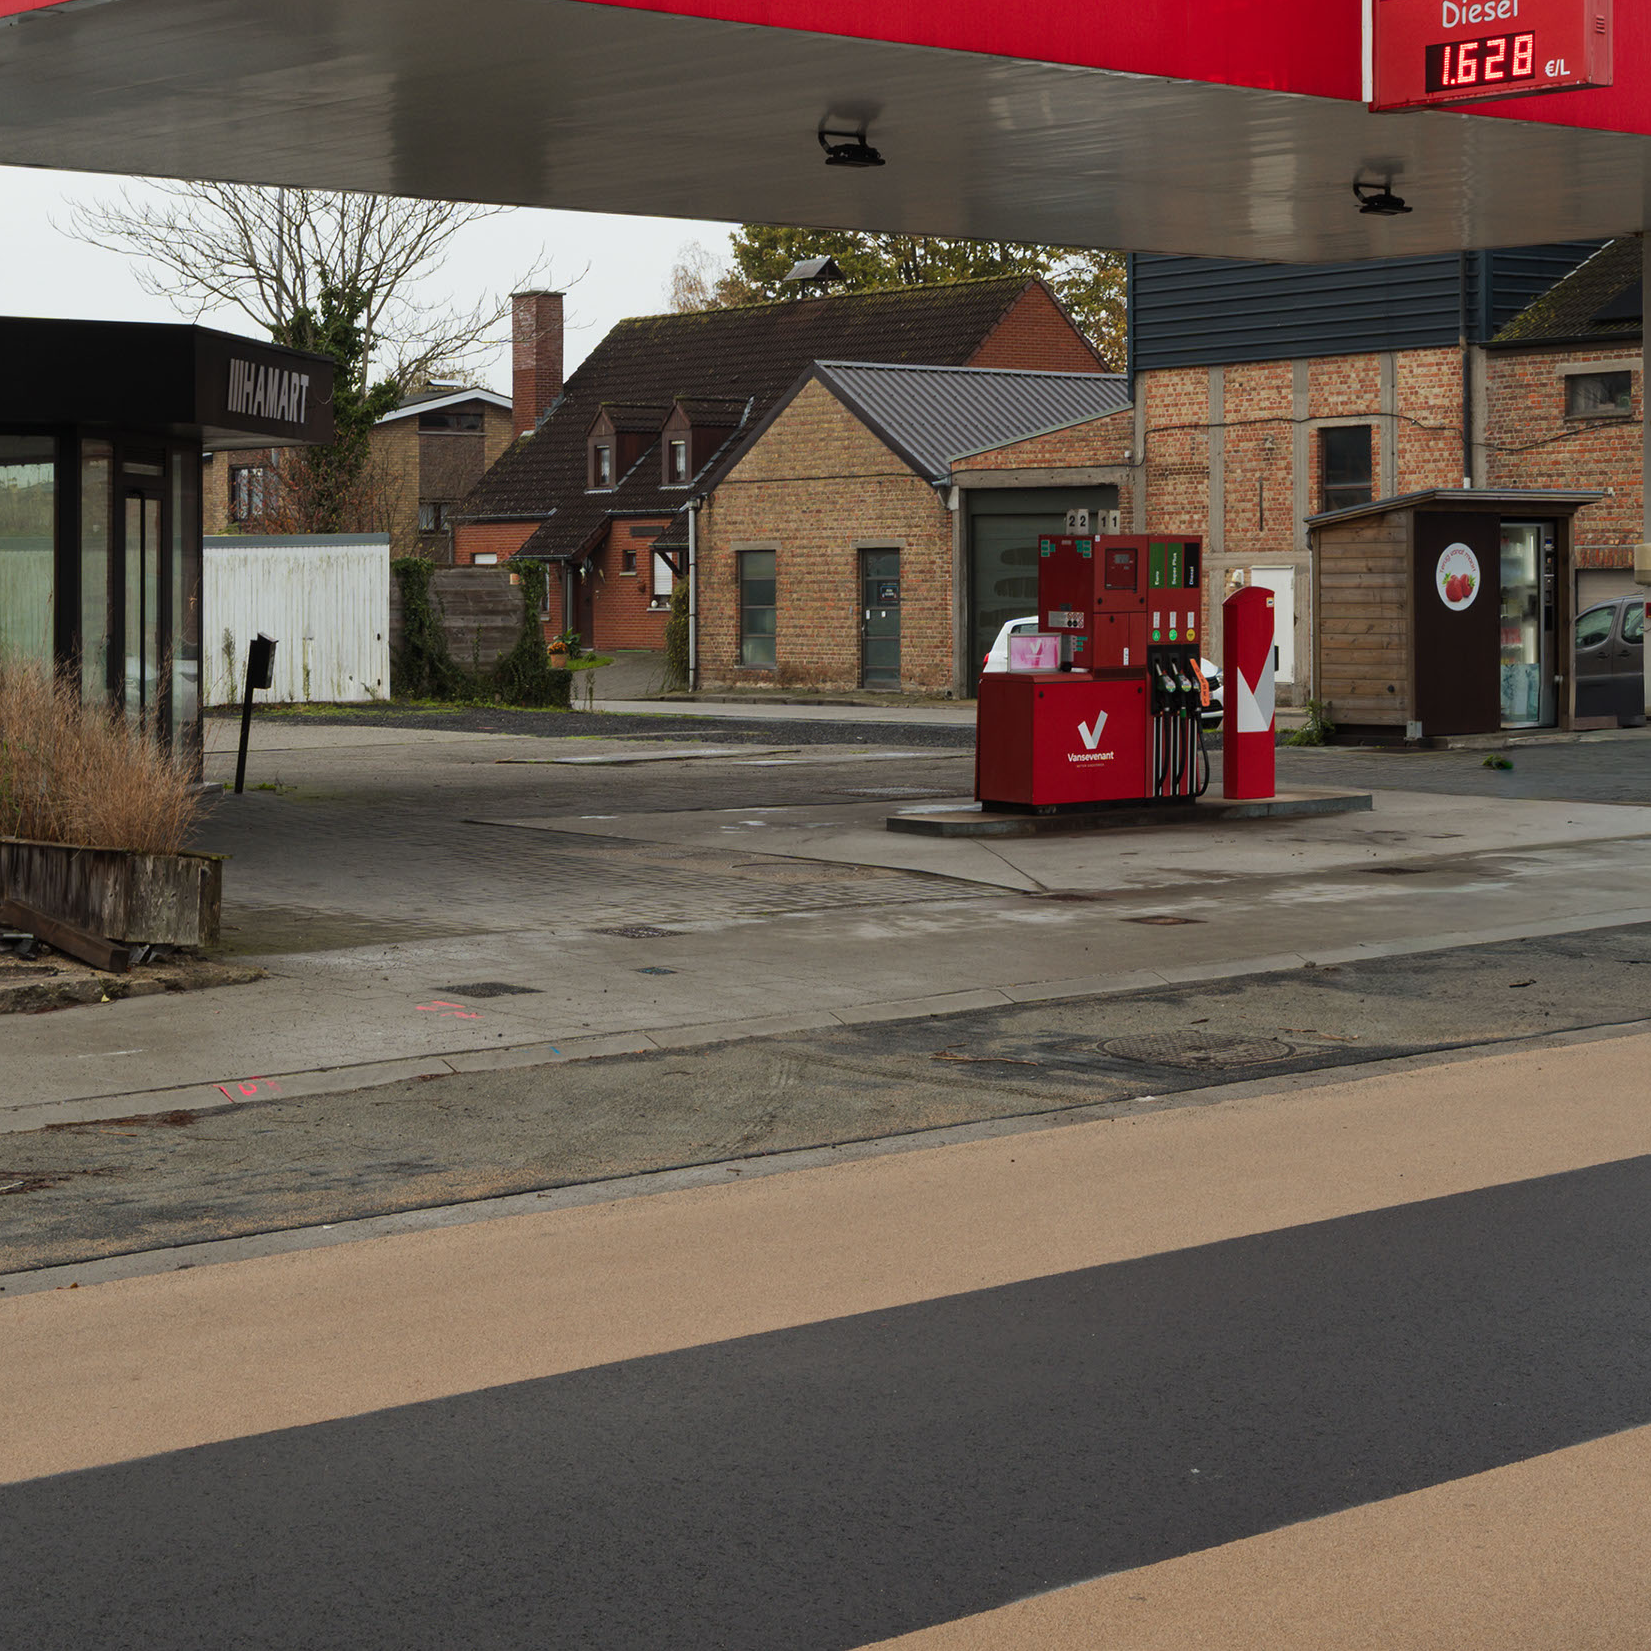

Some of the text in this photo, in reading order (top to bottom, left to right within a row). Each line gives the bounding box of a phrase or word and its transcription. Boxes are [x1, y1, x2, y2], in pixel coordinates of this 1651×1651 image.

[1442, 33, 1570, 86] 1.628 €/L
[1067, 751, 1114, 762] Vansevenant
